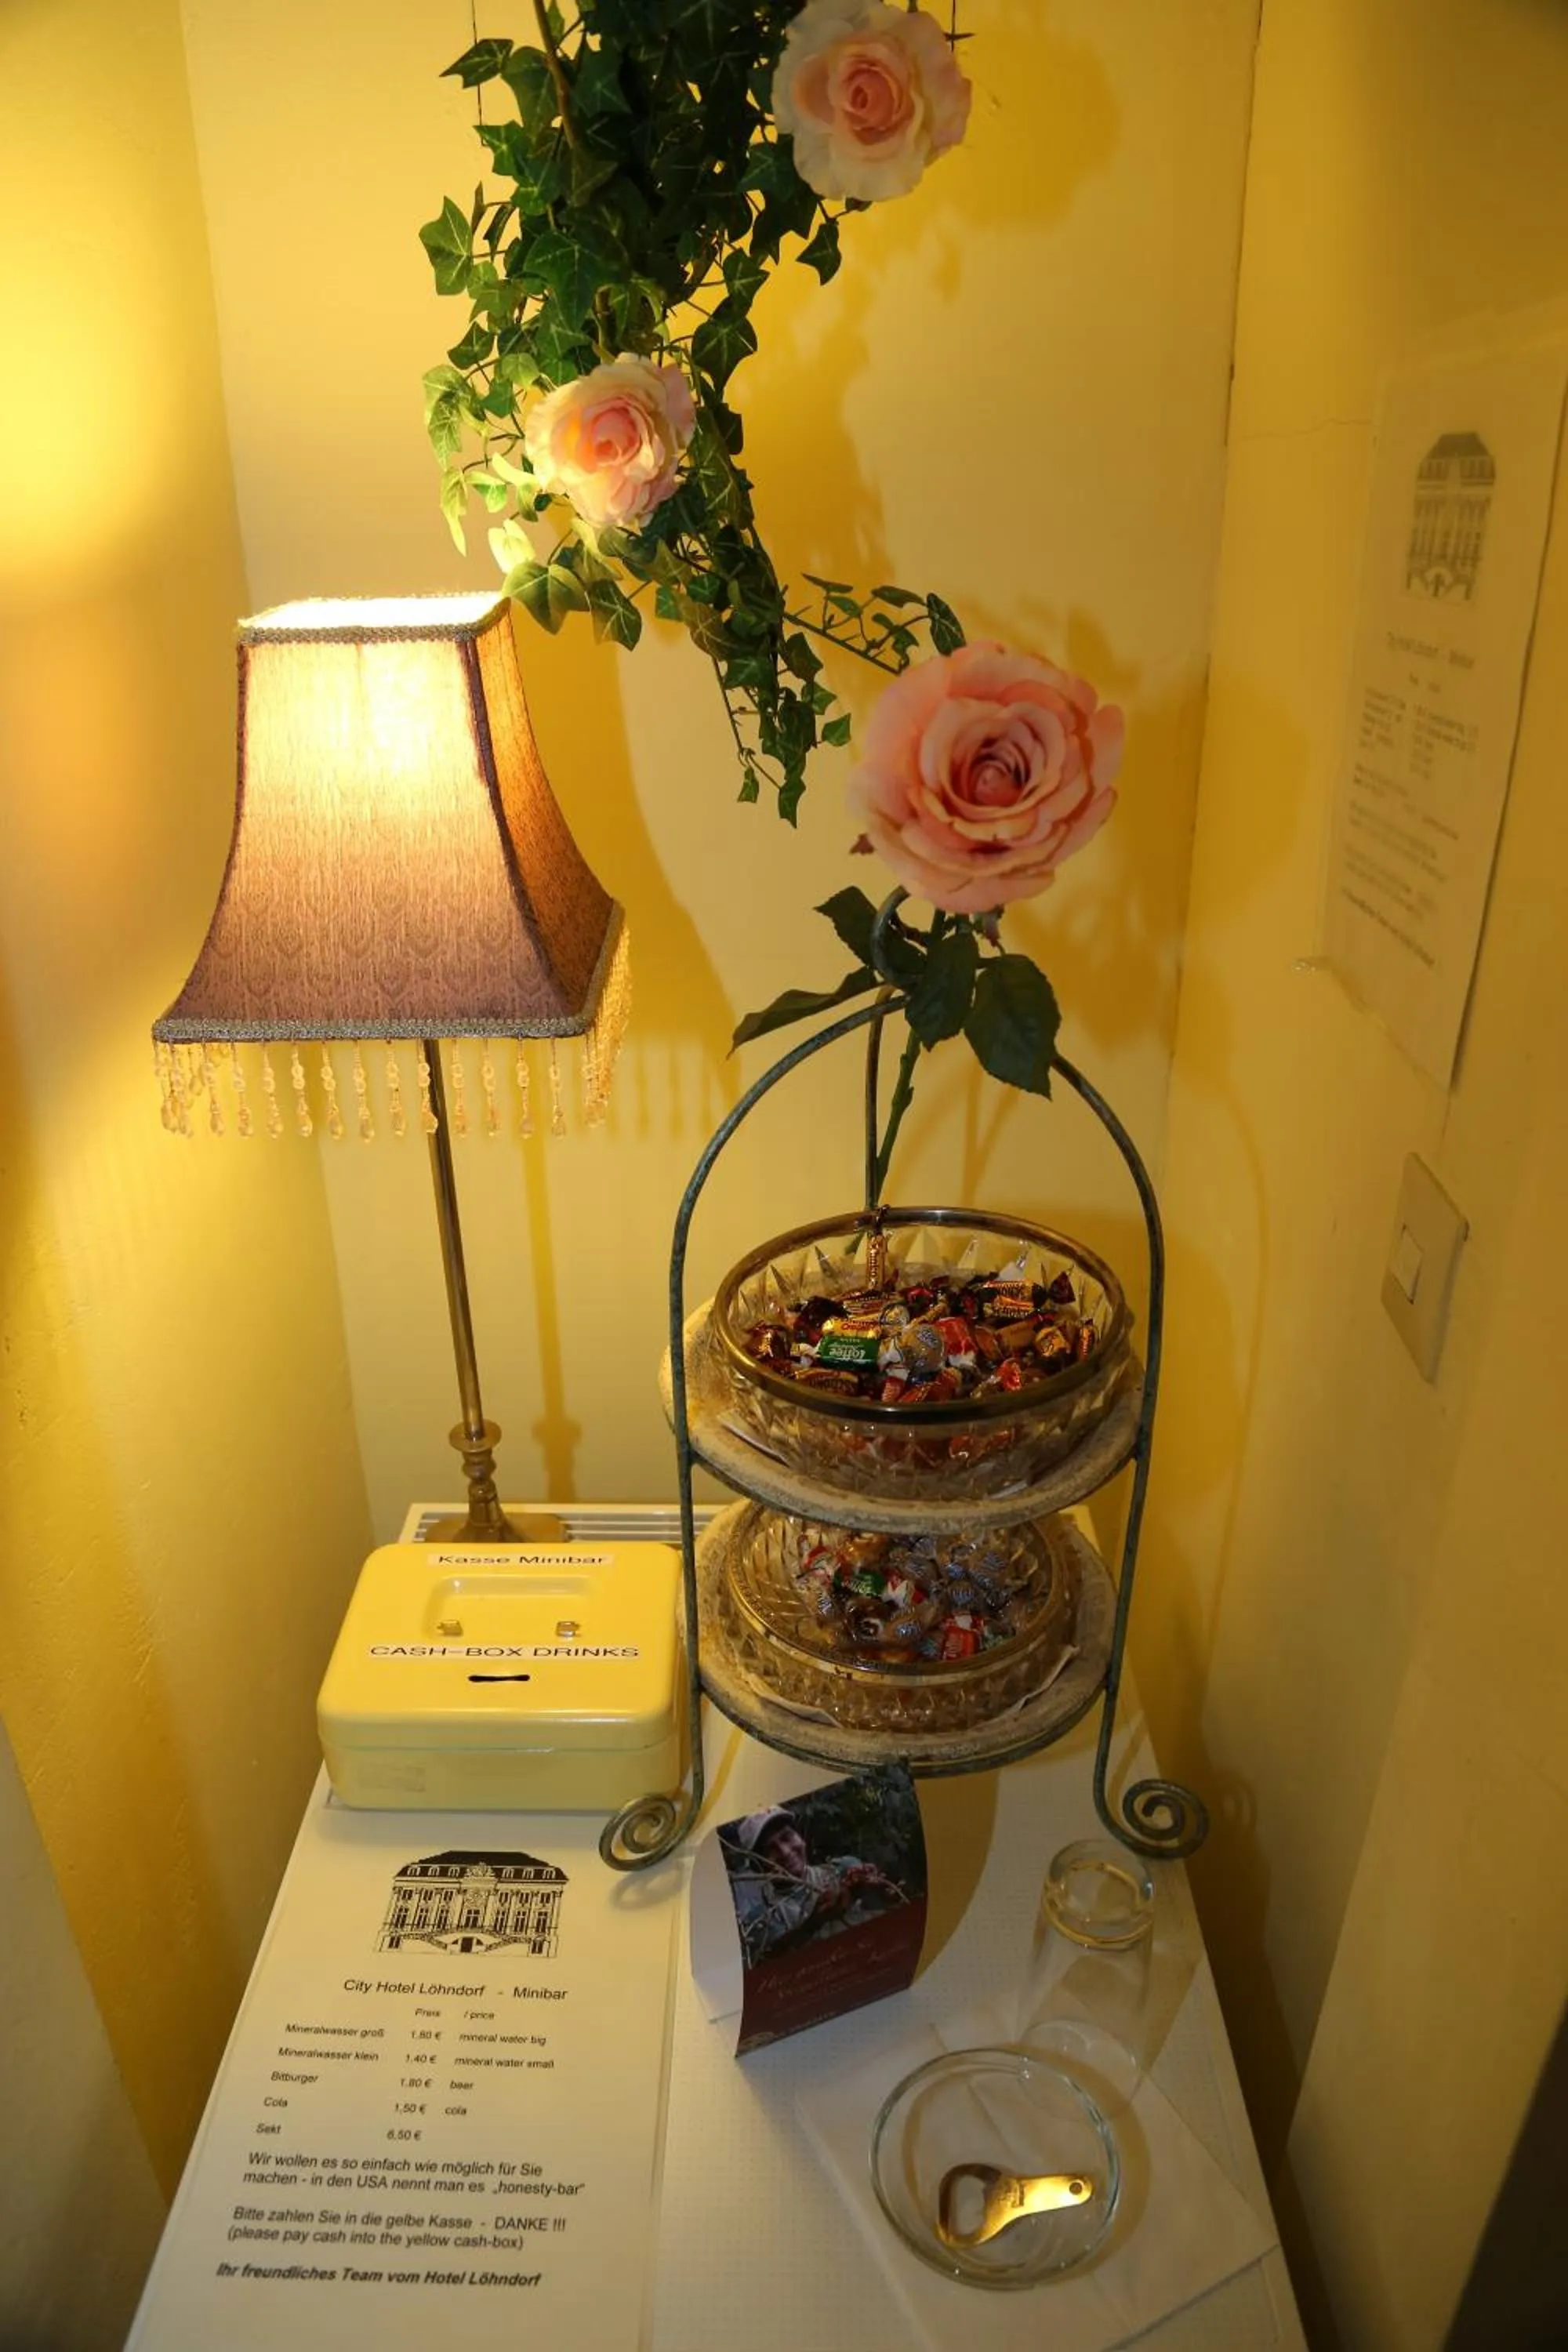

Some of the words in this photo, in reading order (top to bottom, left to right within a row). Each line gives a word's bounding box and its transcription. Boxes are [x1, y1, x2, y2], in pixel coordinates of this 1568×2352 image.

[371, 1647, 522, 1657] CASH-BOX
[533, 1647, 638, 1657] DRINKS
[343, 1979, 372, 1994] City
[376, 1981, 416, 1994] Hotel
[419, 1983, 485, 1996] Löhndorf
[513, 1987, 568, 1999] Minibar
[285, 2024, 358, 2035] Mineralwasser
[459, 2034, 498, 2042] mineral
[530, 2037, 546, 2046] big
[278, 2047, 352, 2060] Mineralwasser
[270, 2071, 318, 2084] Bitburger
[450, 2081, 474, 2089] beer
[263, 2096, 288, 2107] Cola
[445, 2106, 467, 2115] cola
[256, 2122, 281, 2133] Sekt
[414, 2130, 421, 2140] €
[249, 2152, 272, 2165] Wir
[275, 2154, 318, 2168] wollen
[321, 2159, 337, 2169] es
[341, 2159, 358, 2169] so
[361, 2158, 410, 2172] einfach
[415, 2161, 437, 2172] wie
[441, 2161, 494, 2176] möglich
[499, 2162, 517, 2176] für
[520, 2164, 543, 2176] Sie
[243, 2172, 297, 2184] machen
[310, 2174, 322, 2187] in
[327, 2175, 352, 2187] den
[357, 2176, 388, 2189] USA
[392, 2179, 430, 2190] nennt
[434, 2181, 465, 2192] man
[468, 2183, 485, 2193] es
[234, 2206, 264, 2220] Bitte
[267, 2209, 314, 2223] zahlen
[318, 2209, 341, 2224] Sie
[344, 2212, 357, 2225] in
[361, 2212, 382, 2225] die
[386, 2214, 424, 2229] gelbe
[429, 2216, 473, 2228] Kasse
[494, 2216, 548, 2231] DANKE
[227, 2225, 280, 2241] (please
[282, 2230, 310, 2245] pay
[313, 2230, 346, 2243] cash
[350, 2231, 376, 2244] into
[379, 2232, 402, 2245] the
[405, 2234, 449, 2249] yellow
[454, 2235, 524, 2251] cash-box)
[216, 2262, 239, 2277] Ihr
[241, 2263, 337, 2281] freundliches
[342, 2267, 383, 2282] Team
[387, 2274, 420, 2284] vom
[424, 2271, 466, 2285] Hotel
[469, 2272, 541, 2287] Löhndorf
